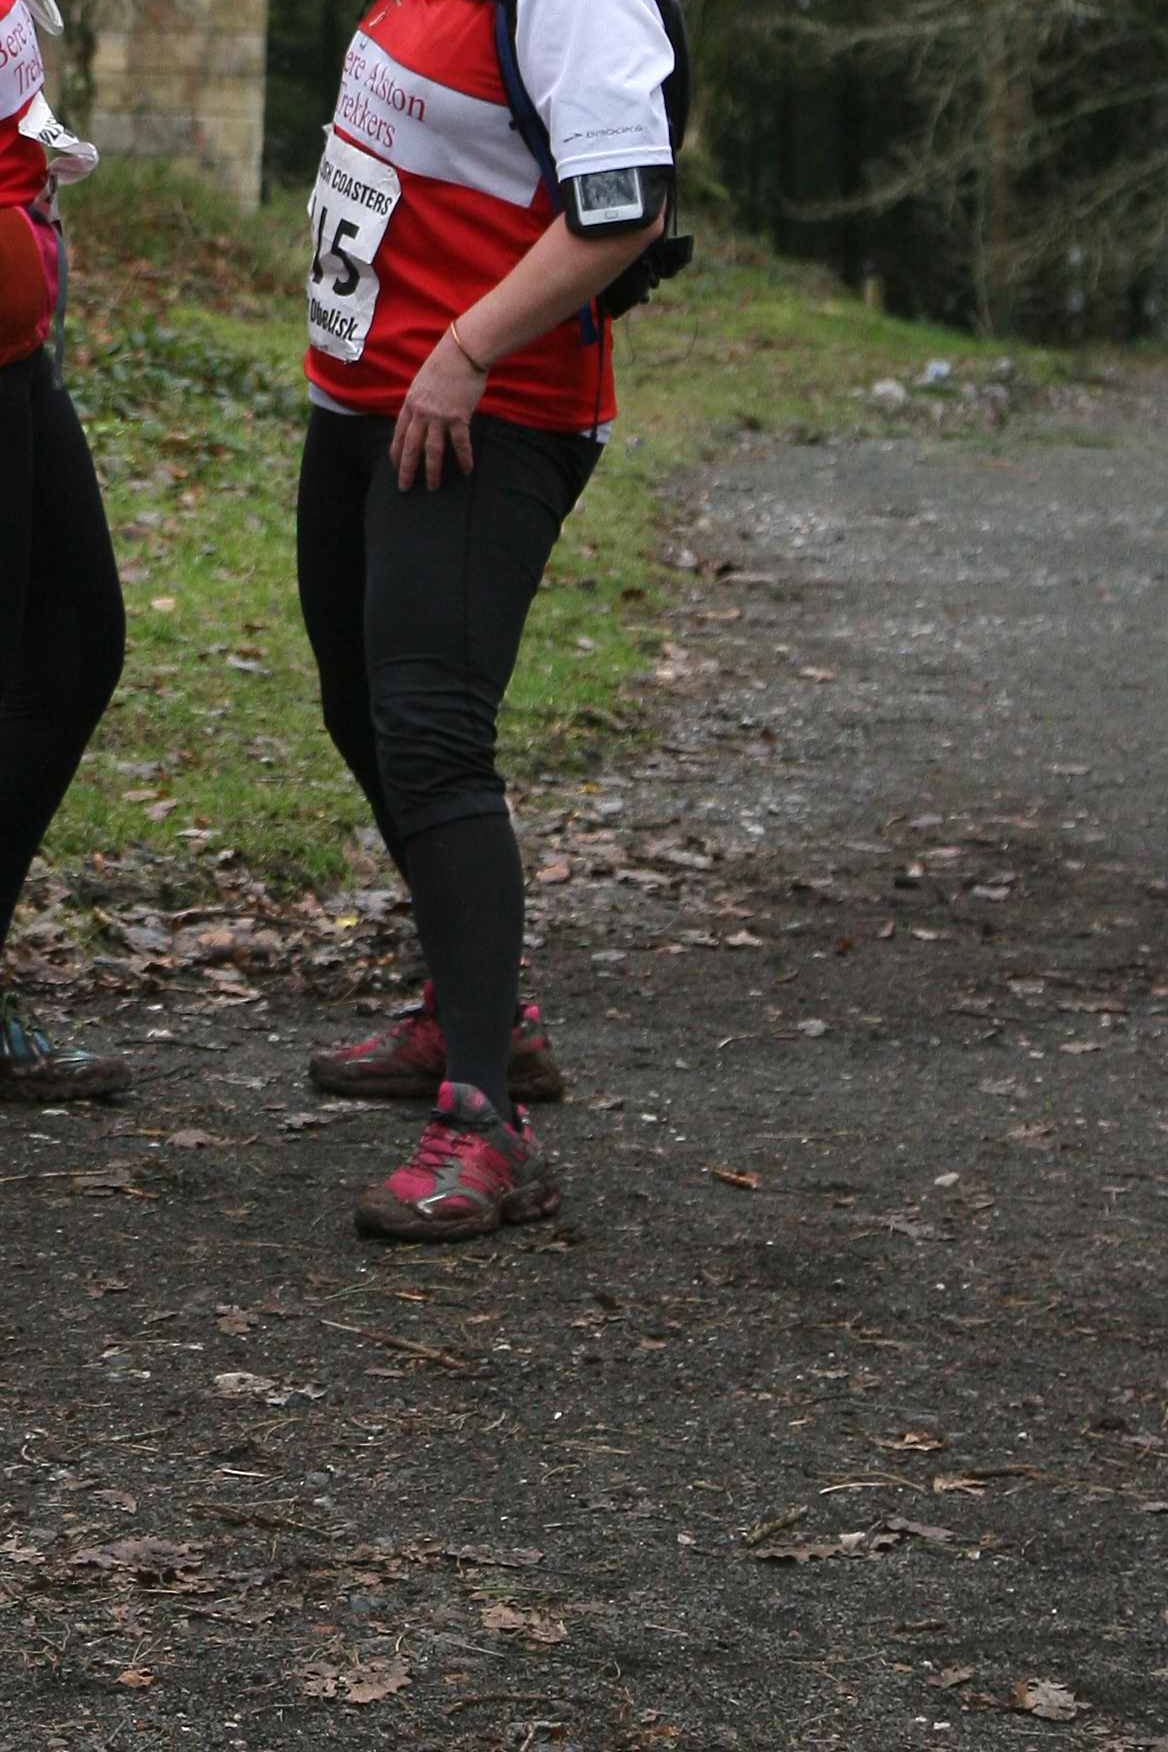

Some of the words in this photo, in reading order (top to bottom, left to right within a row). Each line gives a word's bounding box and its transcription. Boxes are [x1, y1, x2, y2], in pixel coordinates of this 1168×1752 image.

[338, 80, 395, 148] rekkers
[364, 63, 425, 121] Alston
[332, 169, 392, 215] COASTERS
[310, 196, 360, 297] 15
[309, 297, 359, 341] Obelisk
